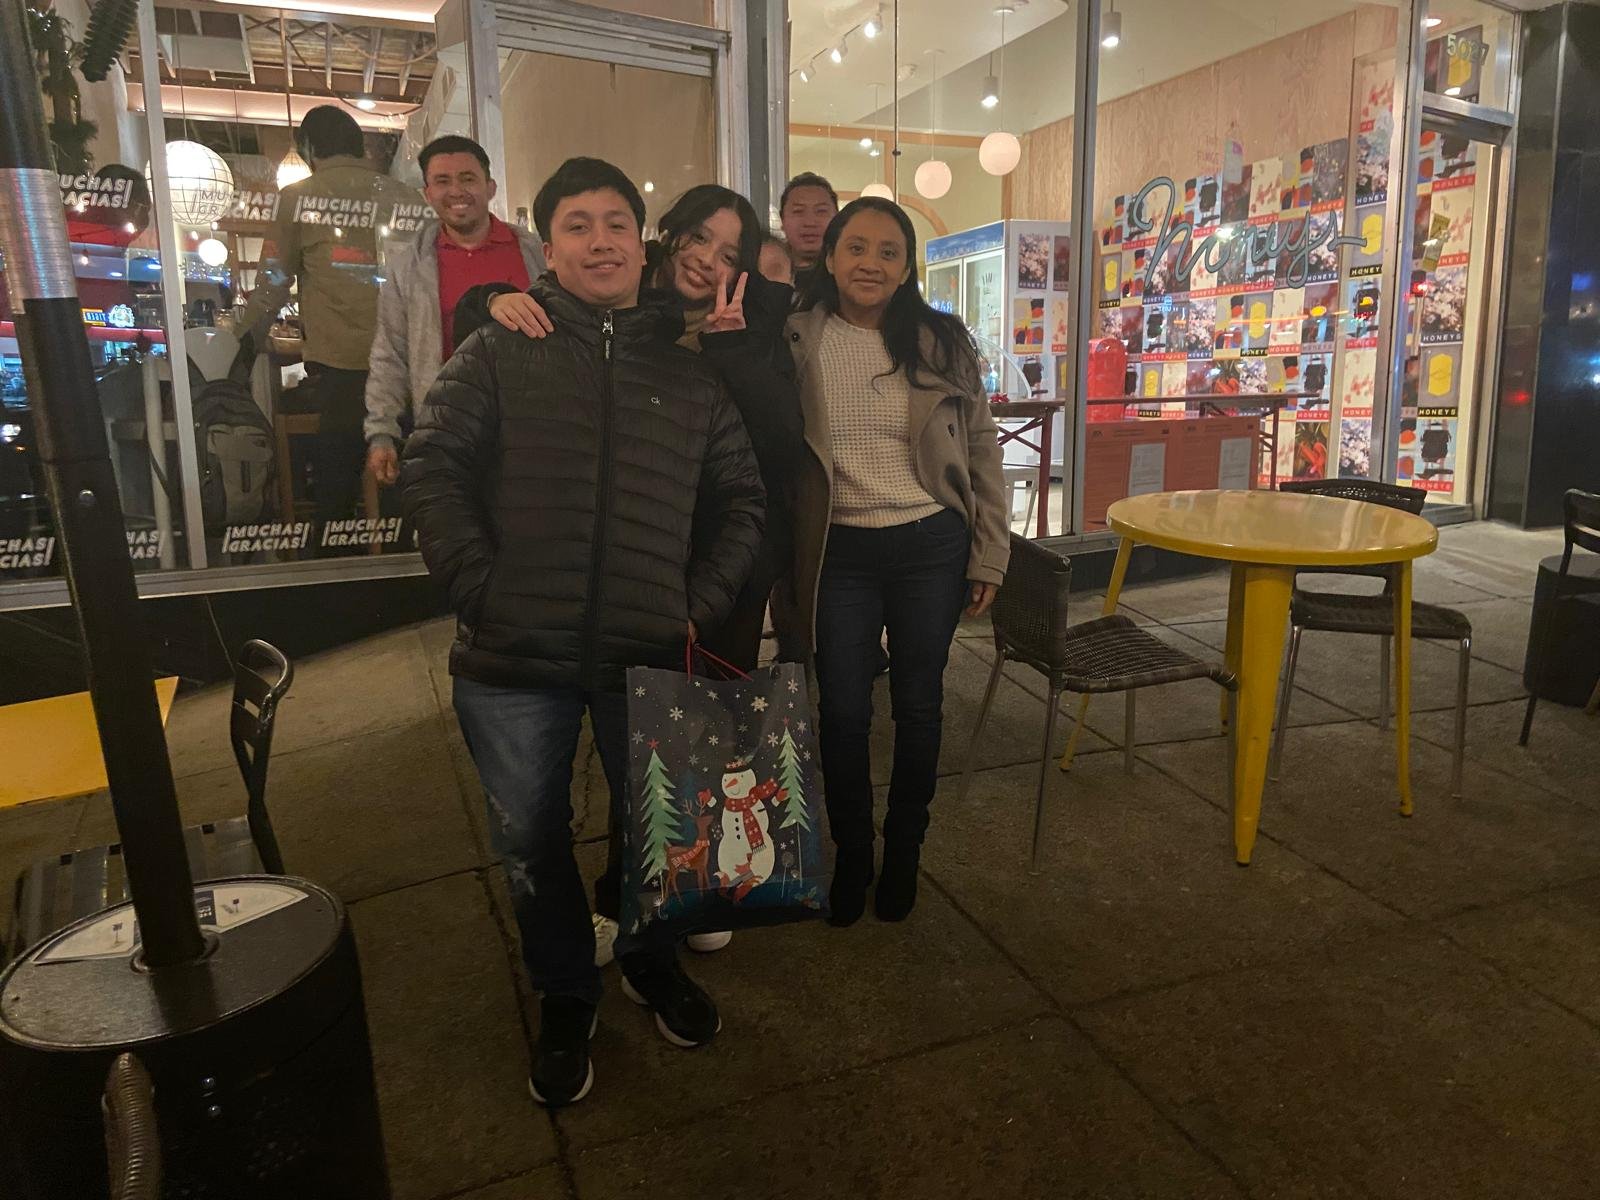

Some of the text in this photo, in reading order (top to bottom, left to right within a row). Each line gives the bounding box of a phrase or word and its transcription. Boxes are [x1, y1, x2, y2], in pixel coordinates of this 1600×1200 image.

[59, 174, 130, 193] UCHAS
[1434, 177, 1474, 189] HONEYS
[61, 190, 129, 209] ACIAS!
[1356, 194, 1385, 204] HONEY
[1439, 254, 1467, 265] NEYS
[1351, 266, 1382, 276] HONEY
[1422, 334, 1461, 342] HONEYS
[1343, 409, 1371, 417] HONEY
[1419, 408, 1456, 416] HONEYS
